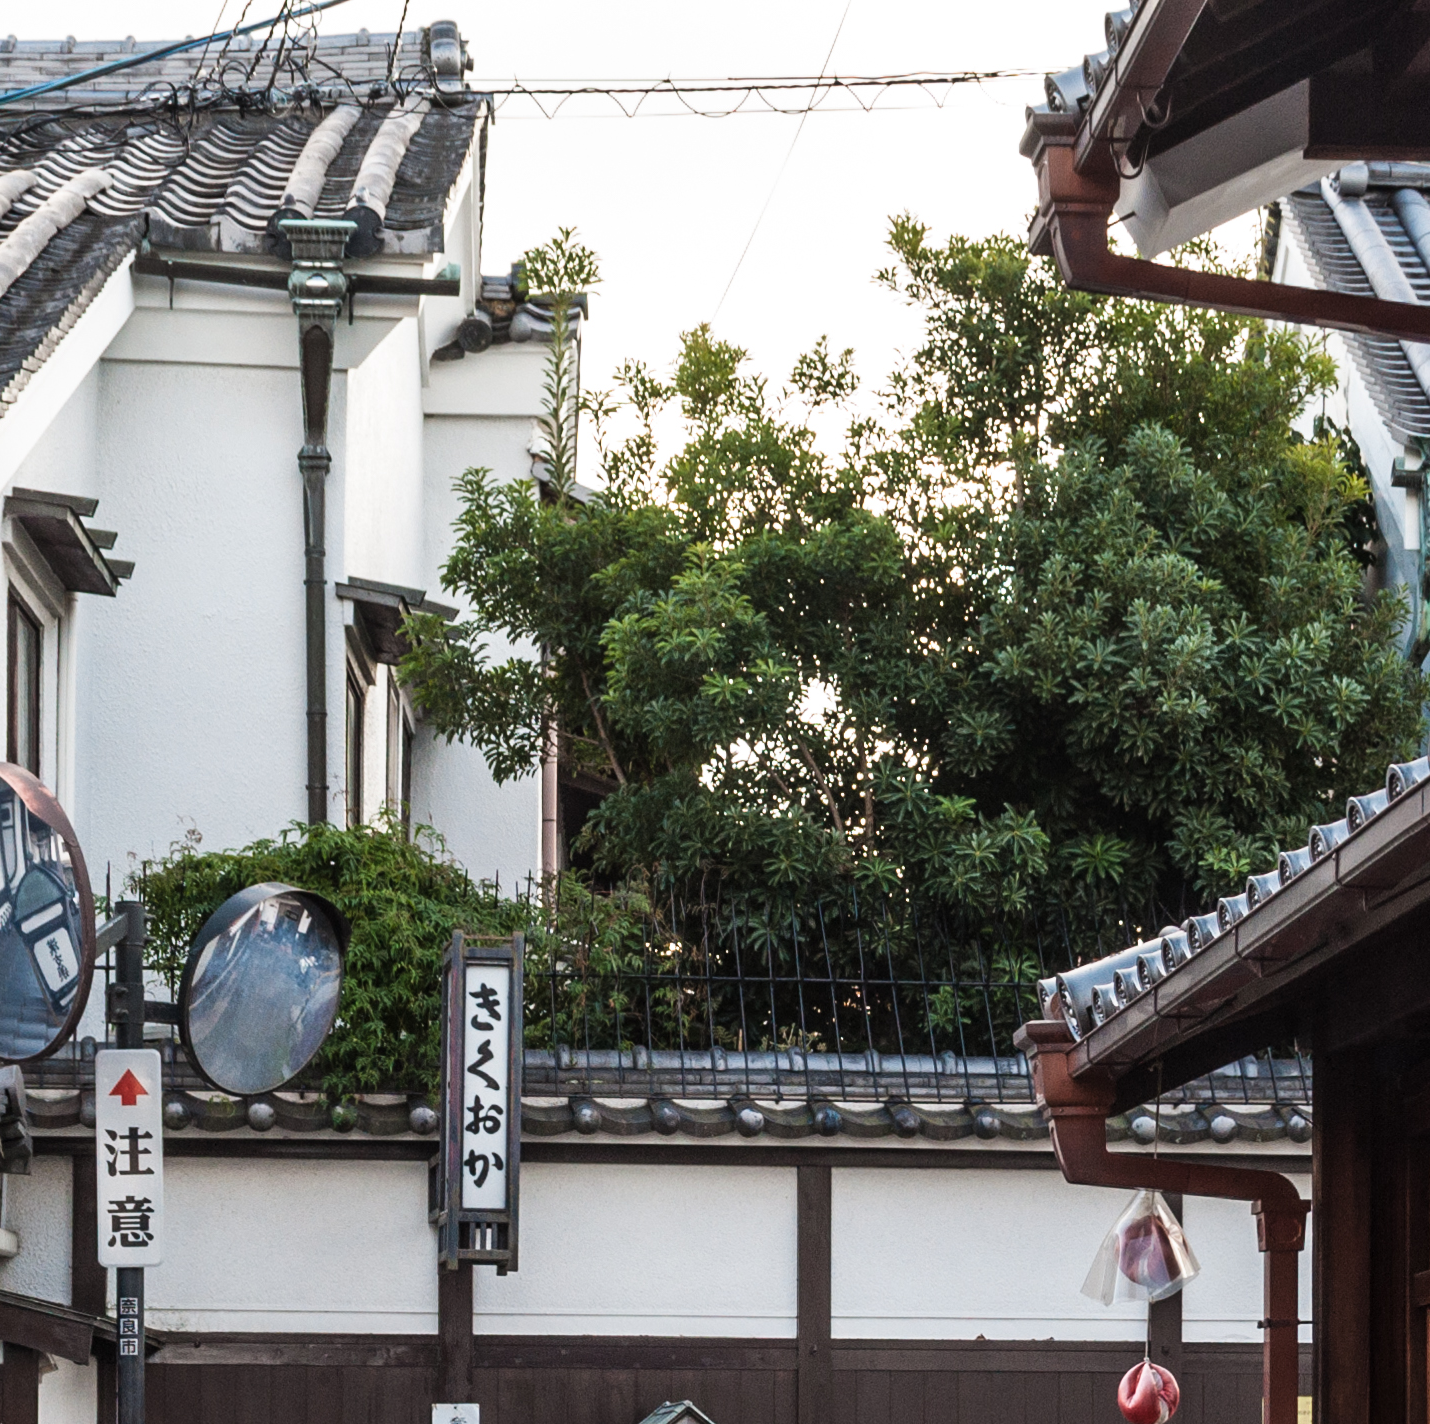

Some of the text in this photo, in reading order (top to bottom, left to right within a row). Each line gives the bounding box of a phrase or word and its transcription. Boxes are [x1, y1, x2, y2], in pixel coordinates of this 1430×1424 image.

[463, 982, 504, 1188] きくおか
[103, 1126, 156, 1249] 注意
[120, 1298, 138, 1355] 奈良市
